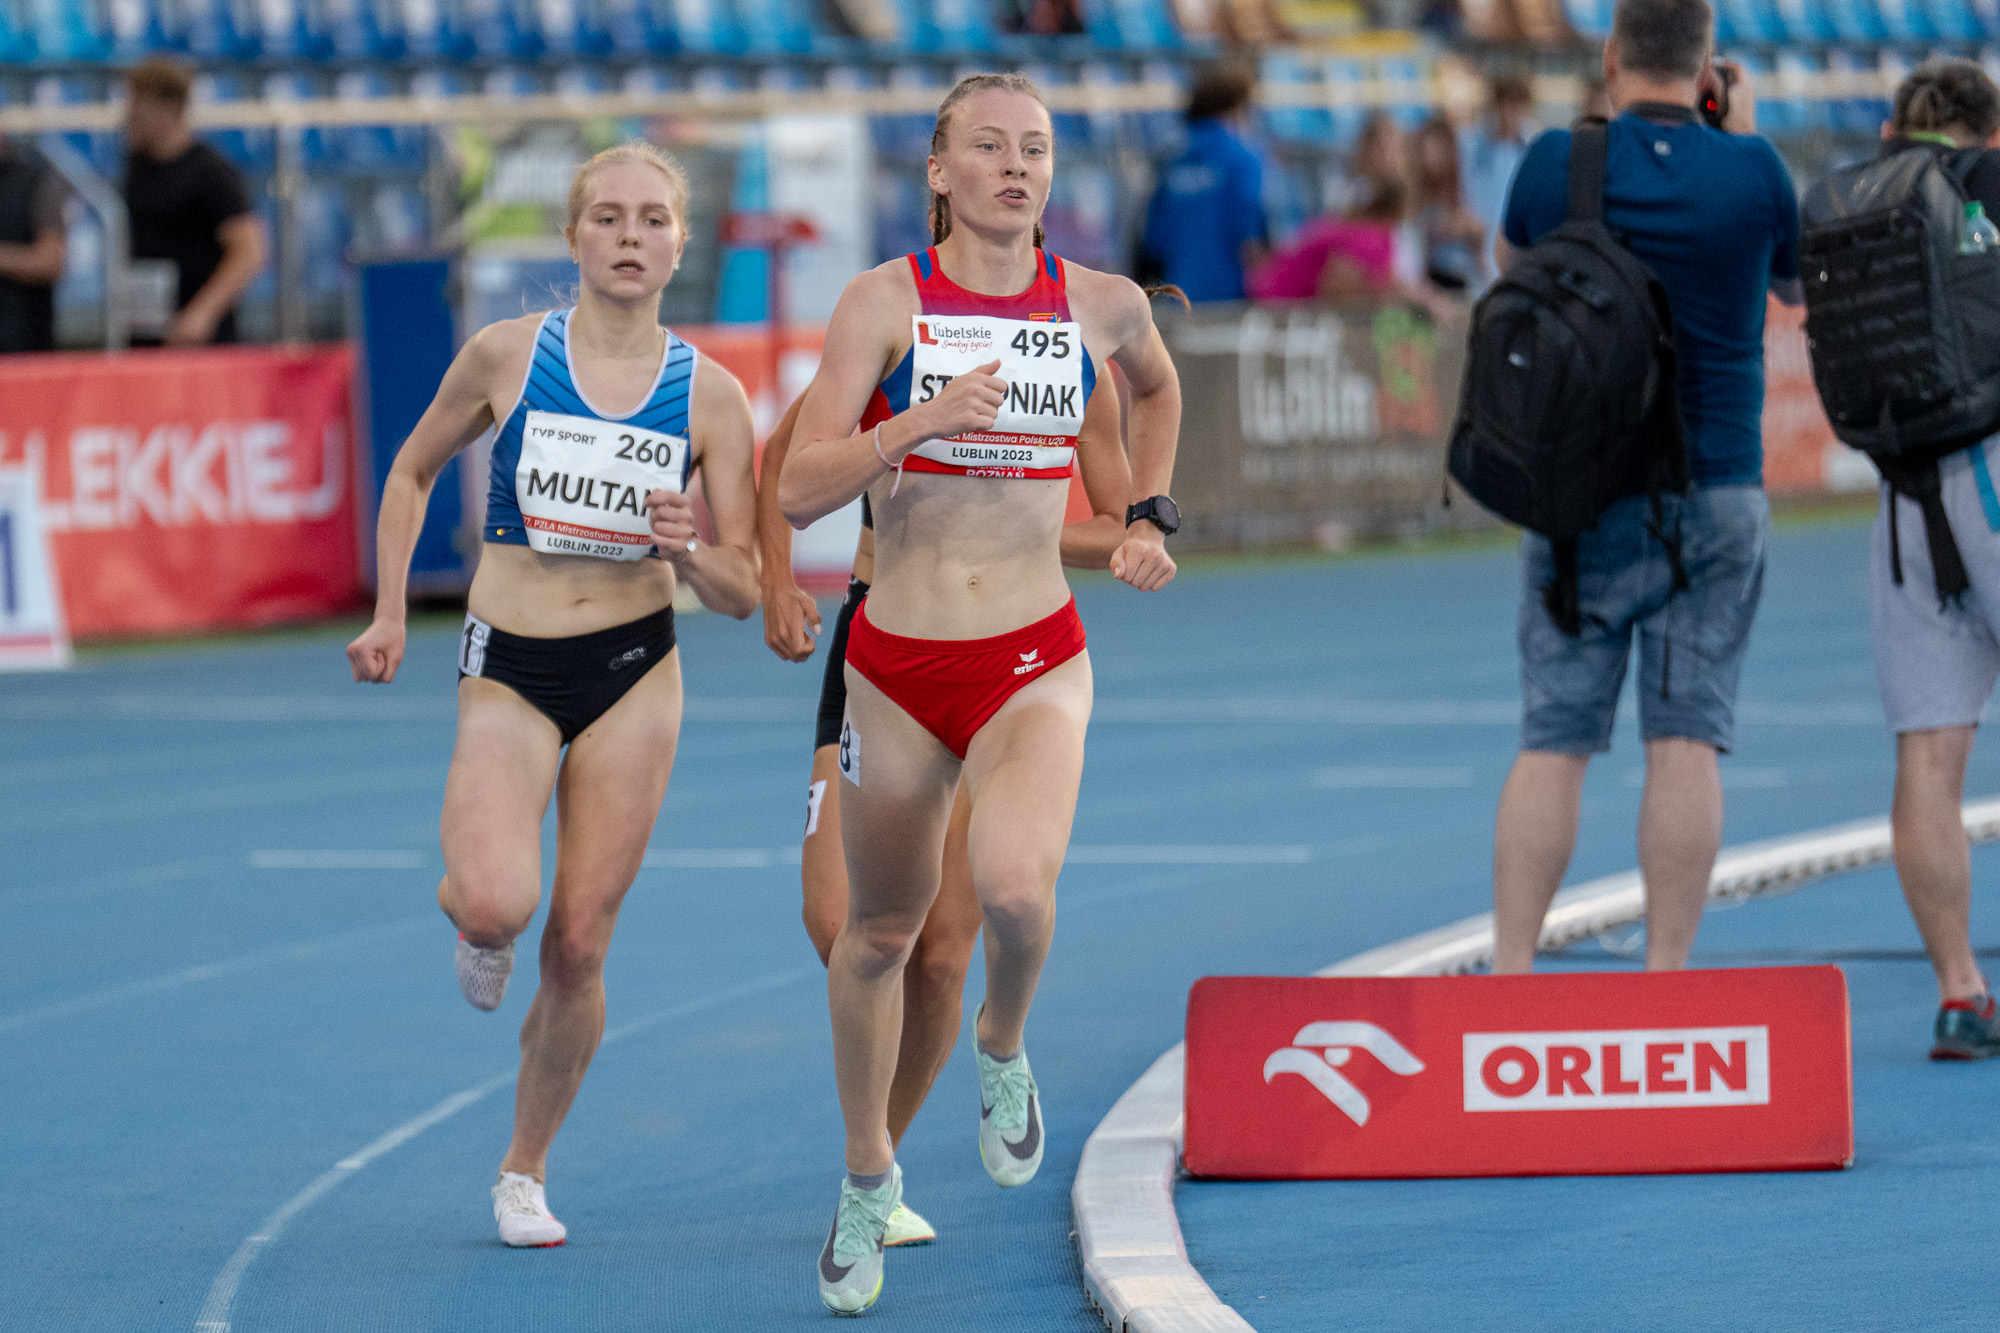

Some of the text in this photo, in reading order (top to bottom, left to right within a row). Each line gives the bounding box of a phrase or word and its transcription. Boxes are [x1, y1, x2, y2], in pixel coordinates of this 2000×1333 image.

[941, 340, 993, 353] Smakuj życie!
[1011, 328, 1070, 359] 495
[531, 427, 596, 445] TVP SPORT
[962, 432, 1017, 444] Mistrzostwa
[1019, 436, 1046, 445] Polski
[1048, 436, 1065, 445] U20
[614, 433, 671, 468] 260
[952, 447, 1033, 461] LUBLIN 2023
[24, 424, 346, 528] LEKKIEJ
[534, 520, 555, 531] PZLA
[557, 524, 611, 540] Mistrzostwa
[613, 533, 638, 544] Polski
[639, 536, 651, 544] U2
[547, 537, 623, 556] LUBLIN 2023
[1013, 660, 1045, 675] erima
[1480, 1040, 1748, 1098] ORLEN
